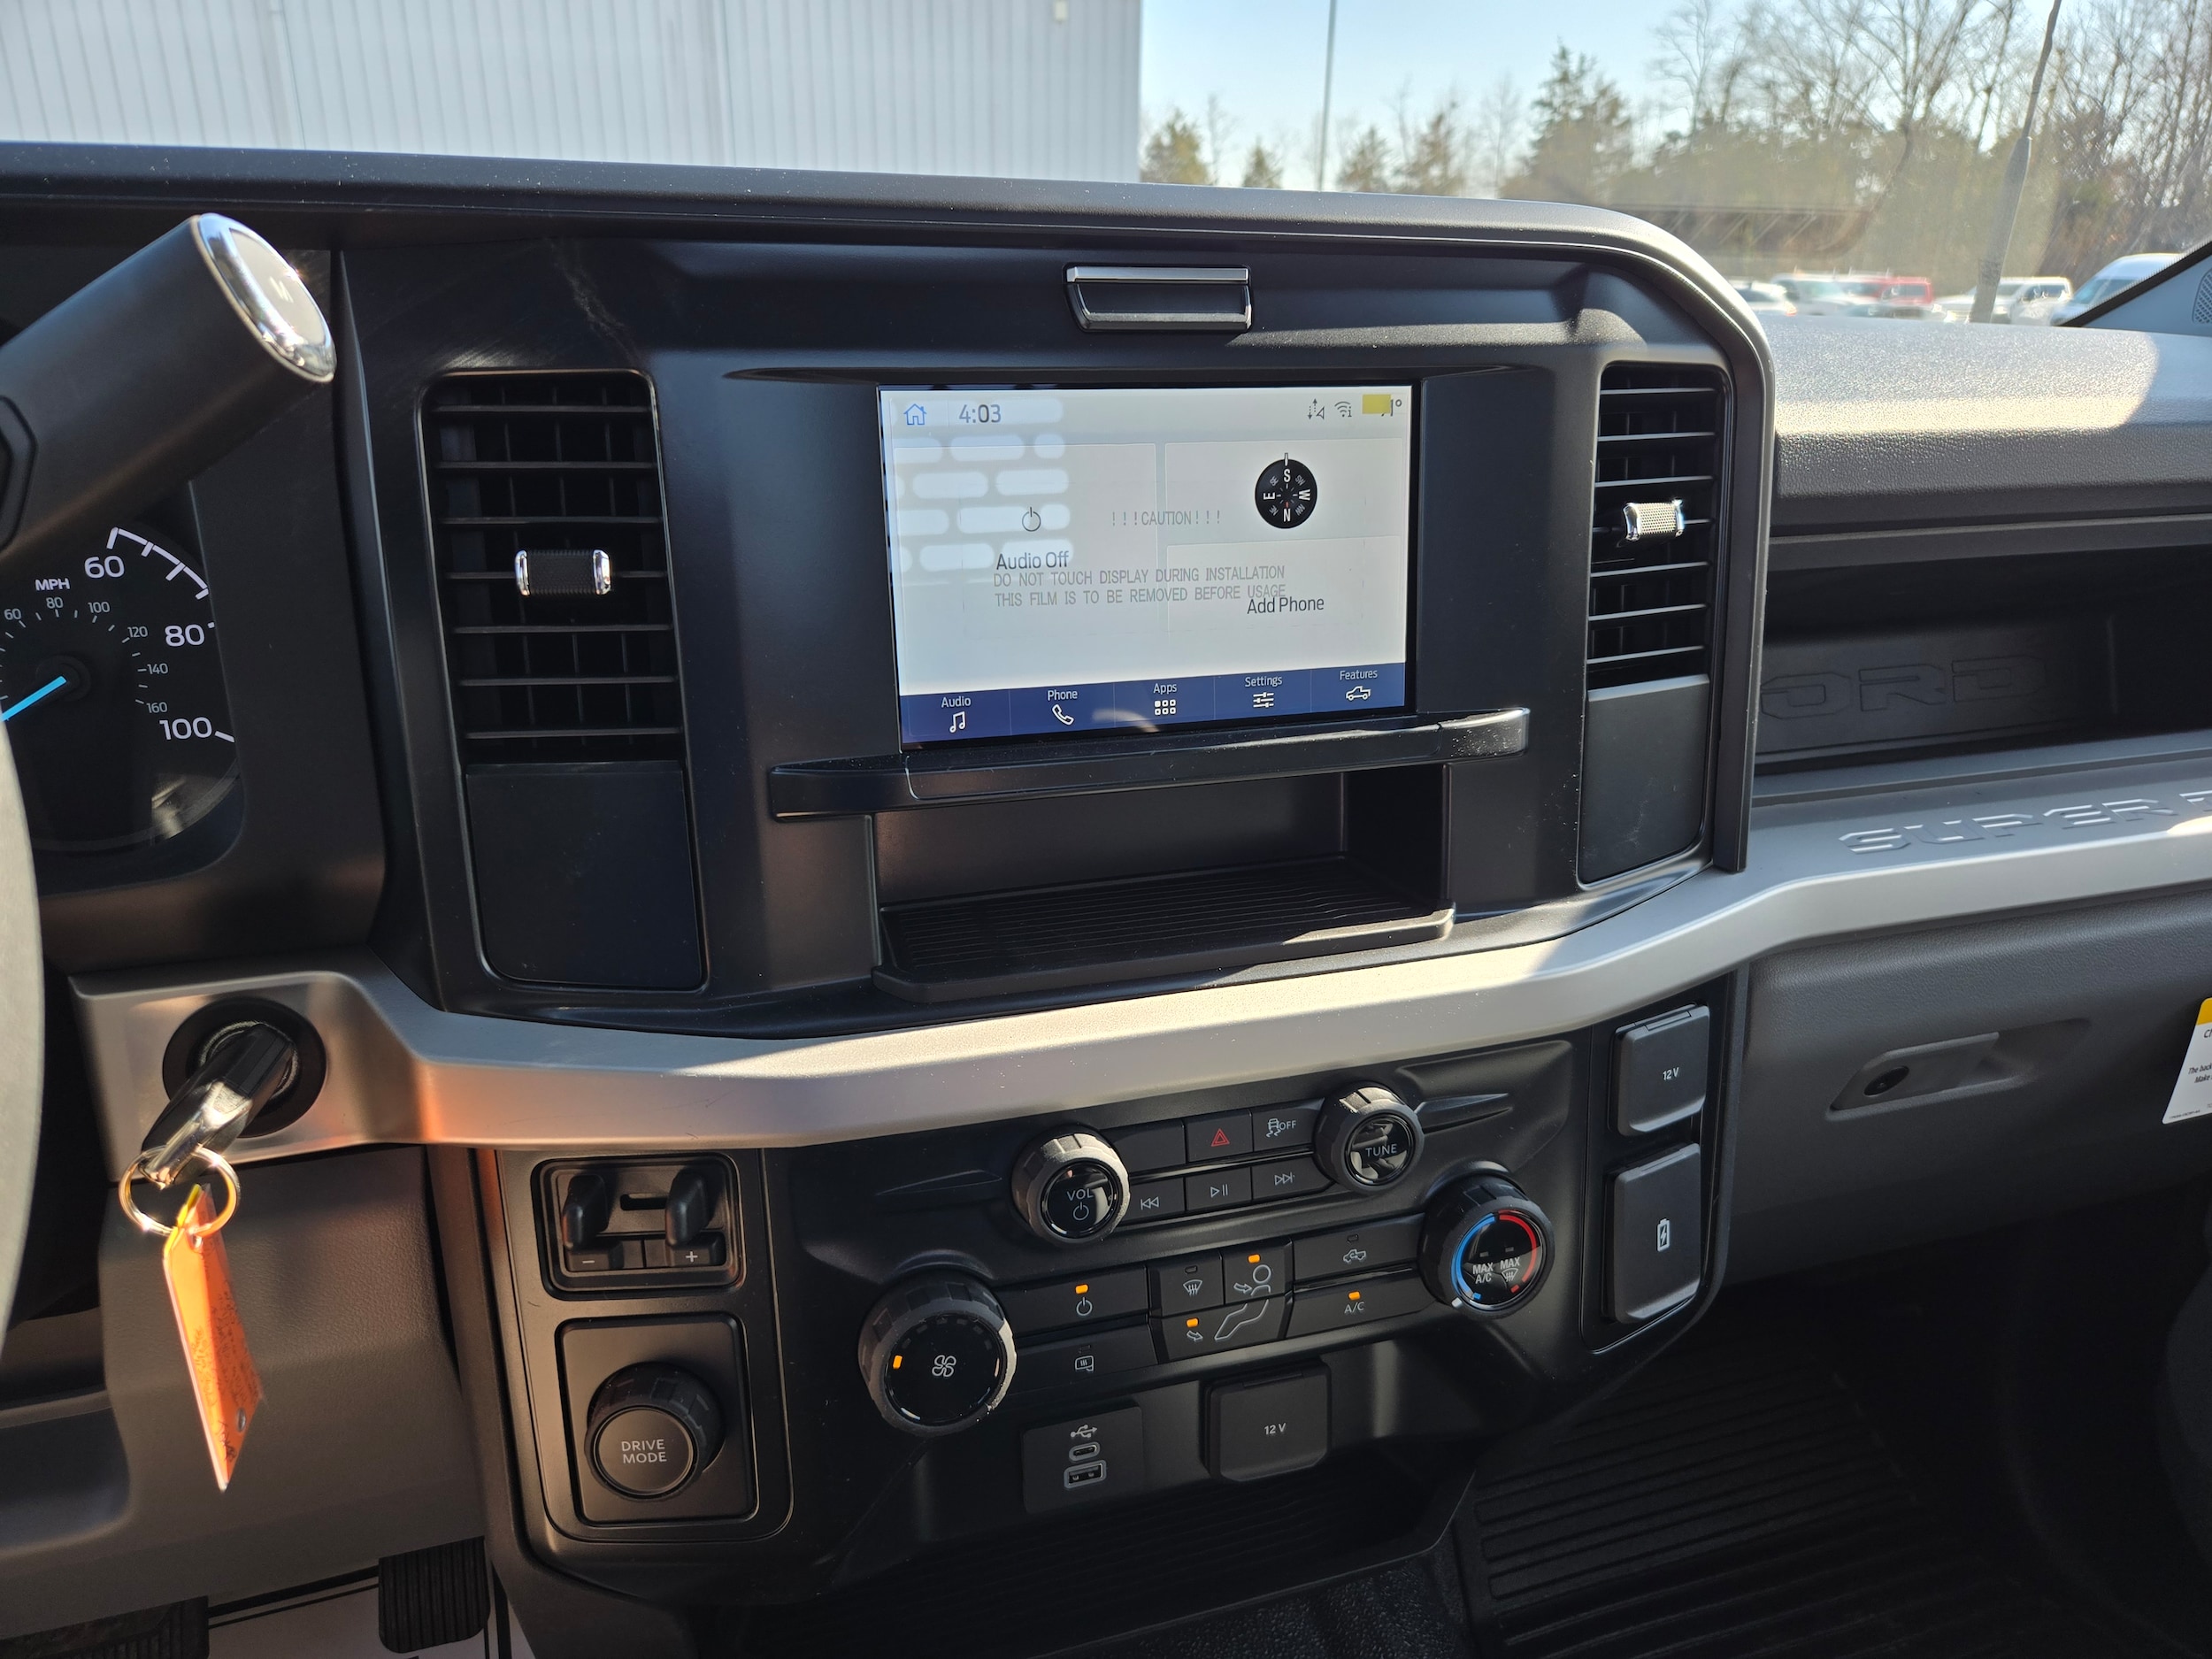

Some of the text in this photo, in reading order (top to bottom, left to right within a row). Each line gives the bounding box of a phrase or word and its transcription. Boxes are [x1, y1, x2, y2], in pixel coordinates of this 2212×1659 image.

[958, 403, 1002, 424] 4:03
[1284, 469, 1291, 482] S
[1298, 488, 1311, 501] W
[1283, 508, 1291, 522] N
[996, 550, 1070, 570] Audio Off
[84, 555, 126, 580] 60
[994, 565, 1286, 587] DO NOT TOUCH DISPLAY DURING INSTALLATION
[35, 578, 71, 591] MPH
[995, 584, 1286, 607] THIS FILM IS TO BE REMOVED BEFORE USAGE
[46, 596, 64, 610] 80
[88, 601, 111, 614] 100
[1247, 595, 1325, 614] Add Phone
[4, 608, 22, 621] 60
[127, 626, 149, 638] 120
[165, 624, 205, 647] 80
[147, 663, 169, 675] 140
[1340, 669, 1378, 680] Features
[1245, 675, 1283, 688] Settings
[1760, 655, 2044, 720] ORD
[1047, 689, 1078, 702] Phone
[1153, 683, 1178, 695] Apps
[146, 701, 168, 714] 160
[941, 695, 972, 709] Audio
[158, 716, 212, 741] 100
[1839, 798, 2179, 854] SUPER
[1663, 1067, 1679, 1080] 12 V
[1279, 1120, 1297, 1131] OFF
[1365, 1142, 1397, 1156] TUNE
[1066, 1188, 1094, 1201] VOL
[1472, 1263, 1494, 1274] MAX
[1500, 1257, 1520, 1269] MAX
[1475, 1272, 1492, 1284] A/C
[1344, 1301, 1364, 1314] A/C
[1264, 1422, 1286, 1435] 12 V
[621, 1439, 665, 1452] DRIVE
[622, 1451, 667, 1464] MODE
